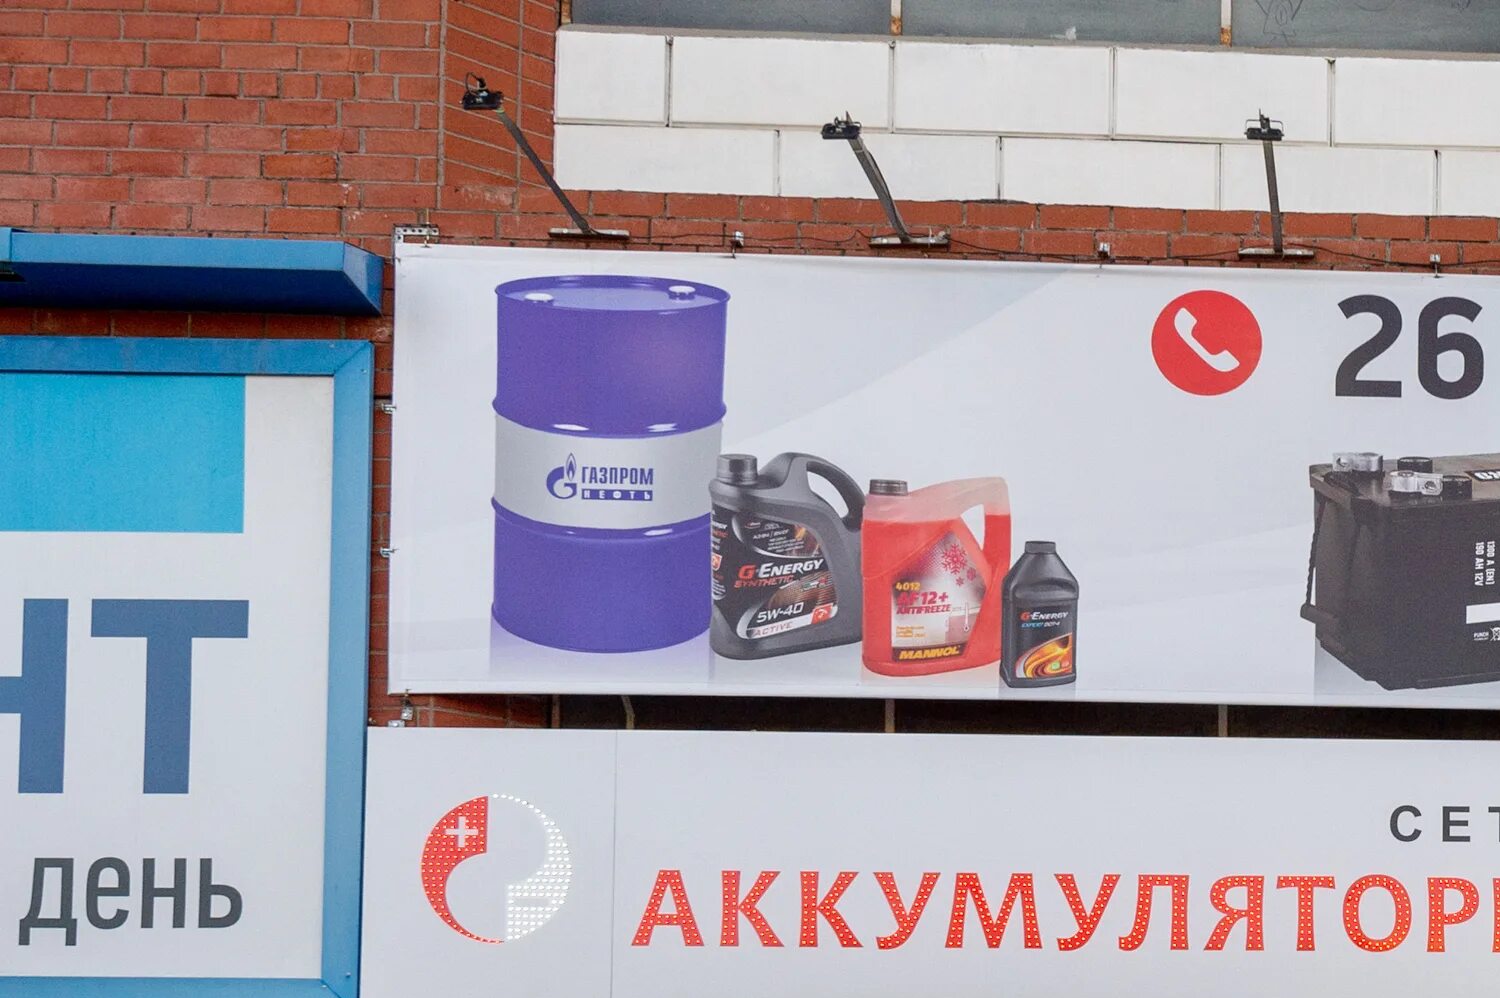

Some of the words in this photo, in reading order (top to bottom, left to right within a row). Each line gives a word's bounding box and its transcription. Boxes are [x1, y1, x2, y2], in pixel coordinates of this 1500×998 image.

[582, 466, 653, 485] ГАЗПРОМ
[583, 489, 651, 500] НЕФТЬ
[1475, 542, 1484, 555] 190
[1475, 558, 1484, 570] AH
[734, 575, 795, 588] SYNTHETIC
[895, 581, 920, 592] 4012
[921, 591, 948, 605] 12+
[757, 602, 804, 623] 5W-40
[896, 603, 951, 615] ANTIFREEZE
[753, 621, 793, 637] ACTIVE
[899, 646, 960, 660] MANNOL
[18, 857, 243, 946] день
